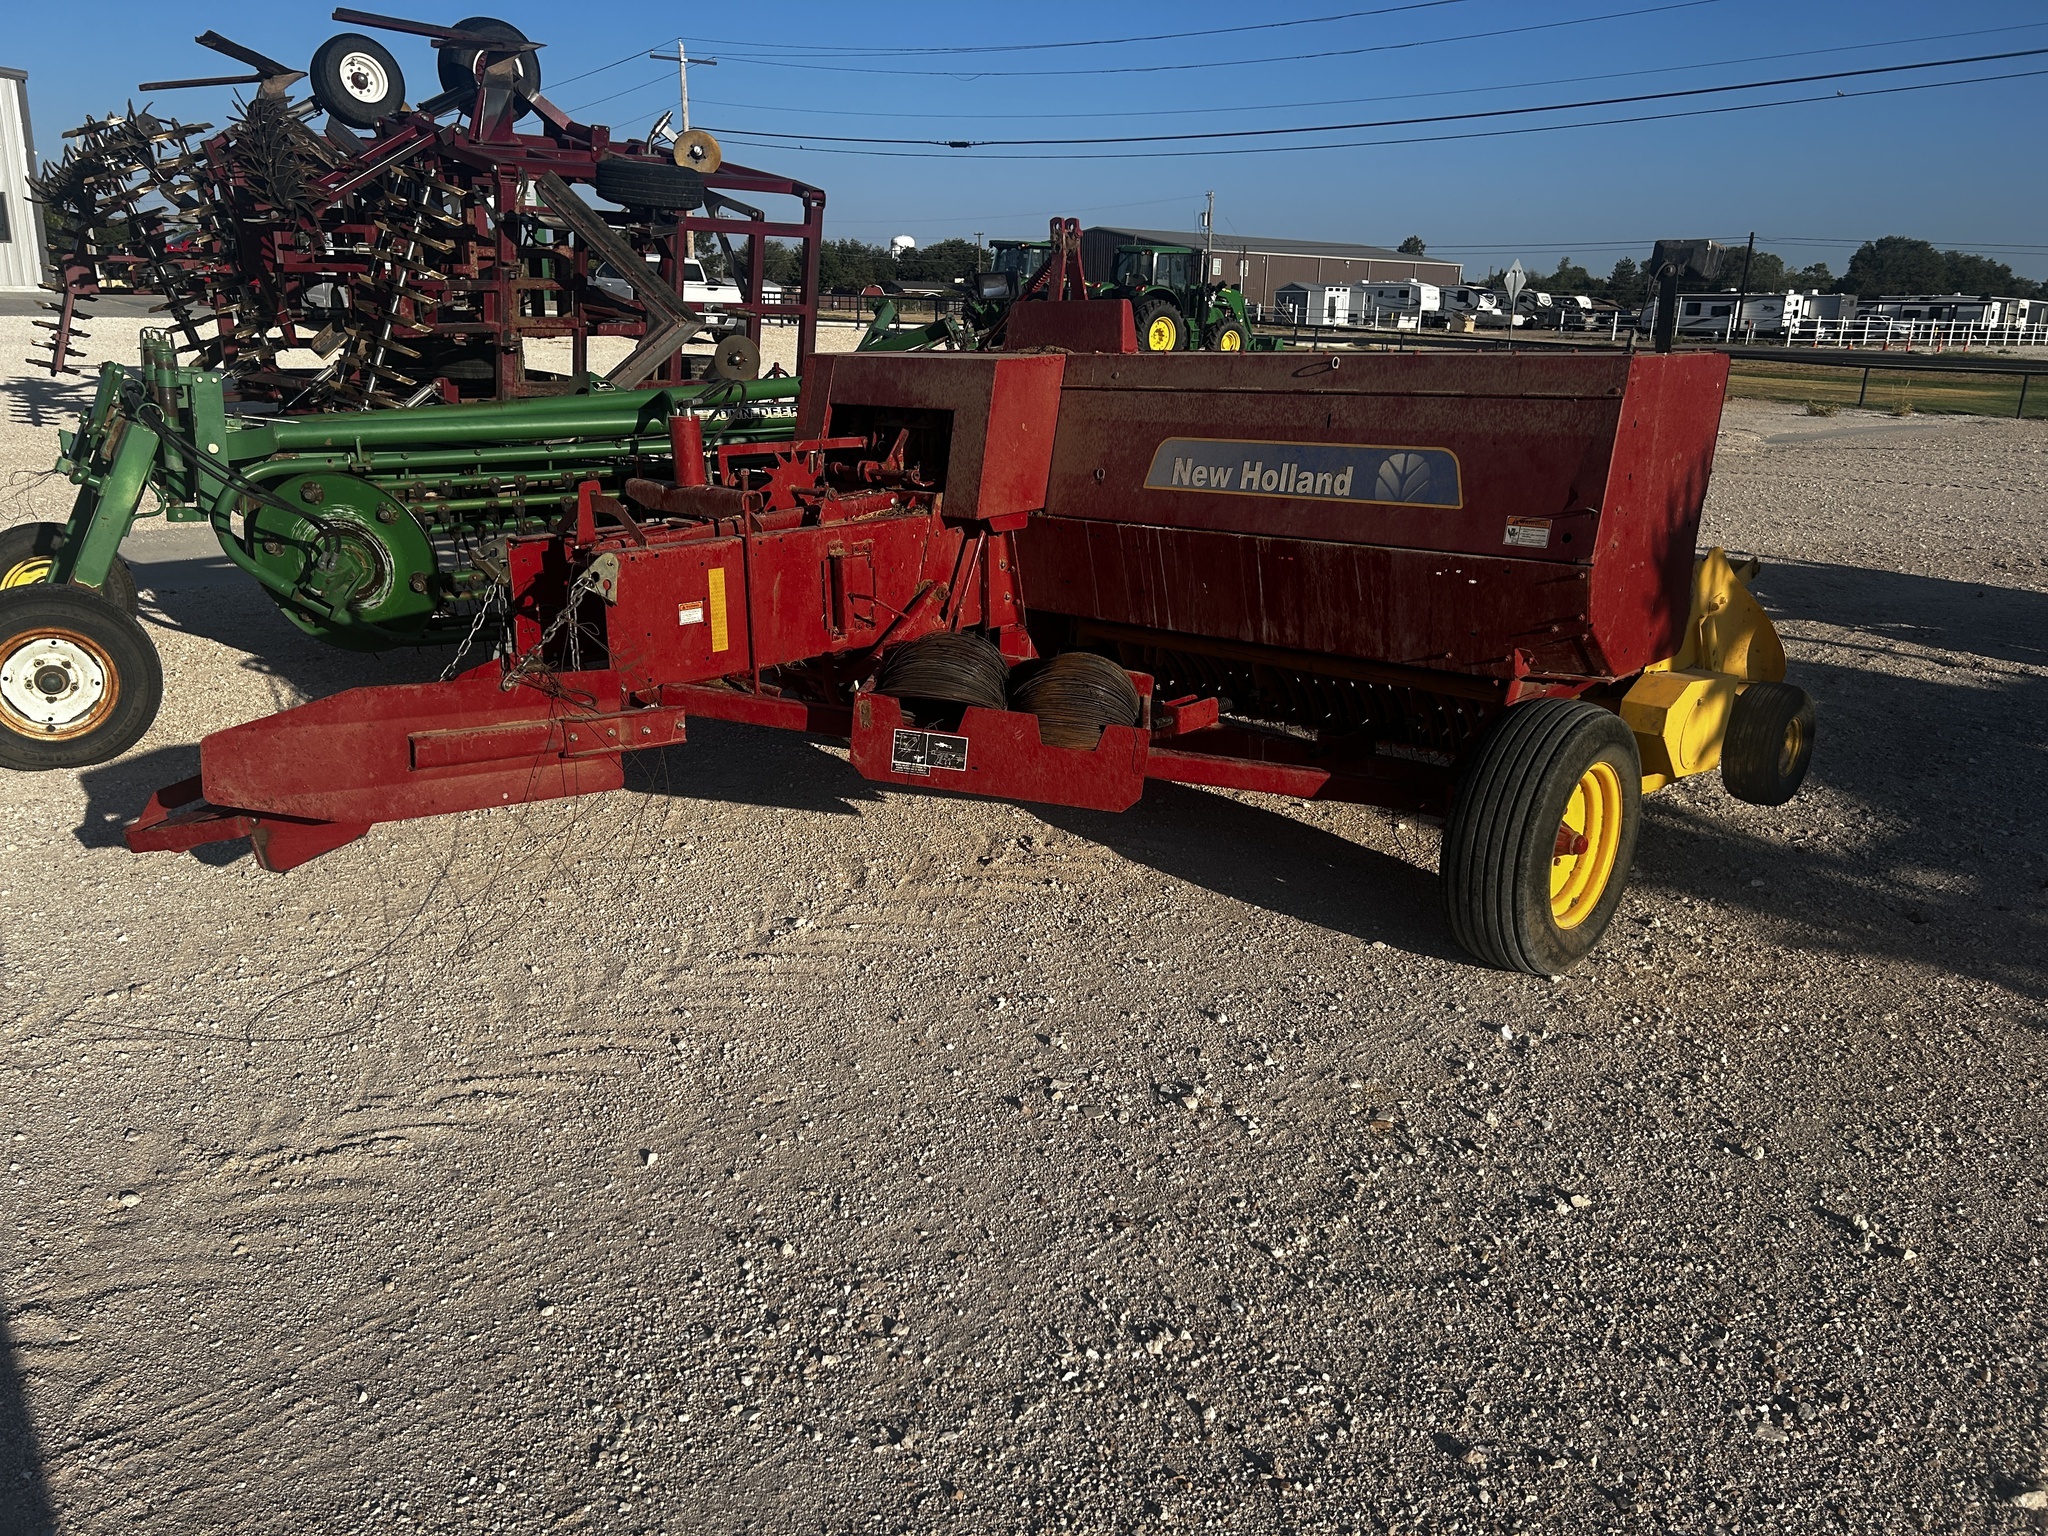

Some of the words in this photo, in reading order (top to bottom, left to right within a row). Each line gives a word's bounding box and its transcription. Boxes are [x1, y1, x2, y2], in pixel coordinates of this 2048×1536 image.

[712, 406, 752, 420] OHN
[758, 405, 799, 419] DEER
[1171, 457, 1233, 488] New
[1239, 460, 1354, 497] Holland
